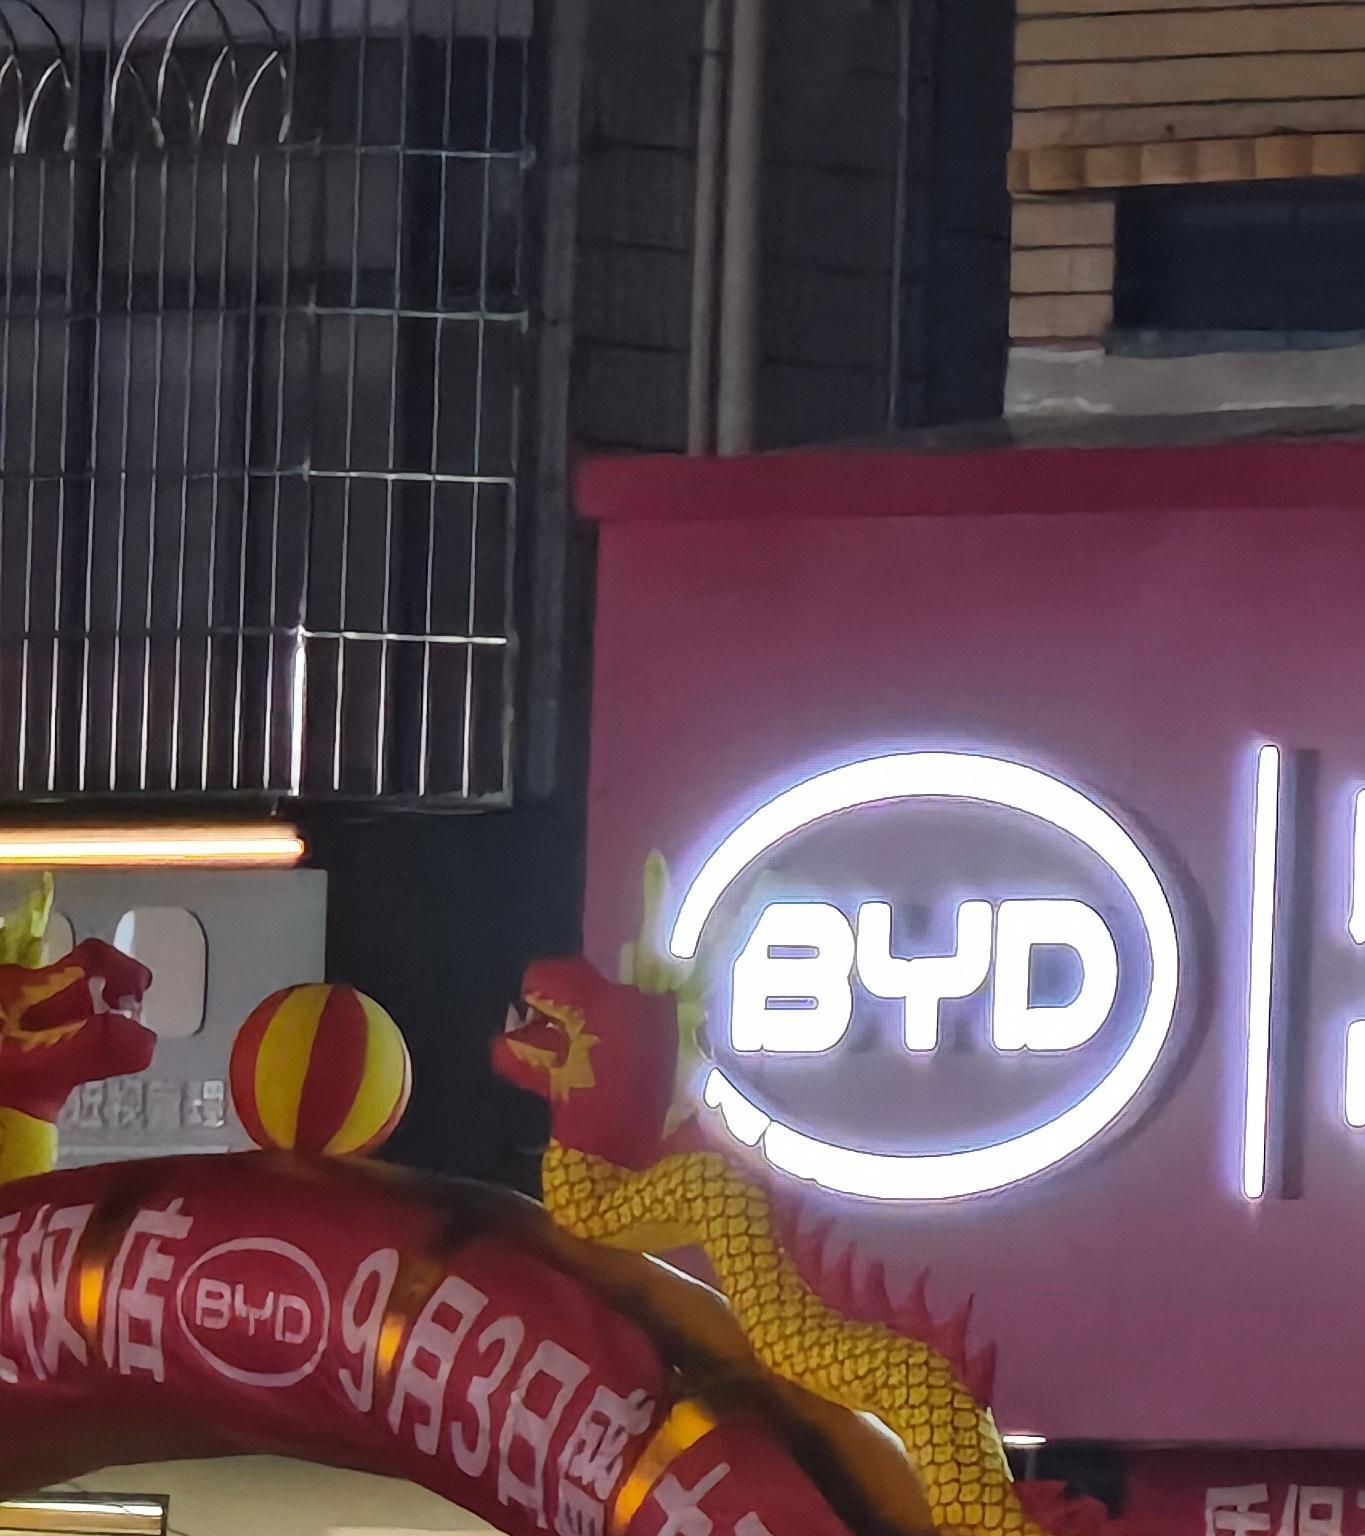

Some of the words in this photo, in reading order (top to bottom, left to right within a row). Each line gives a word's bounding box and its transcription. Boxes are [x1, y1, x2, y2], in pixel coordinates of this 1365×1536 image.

[730, 898, 1120, 1053] BYD
[0, 1196, 194, 1384] 权店
[195, 1277, 312, 1345] BYD
